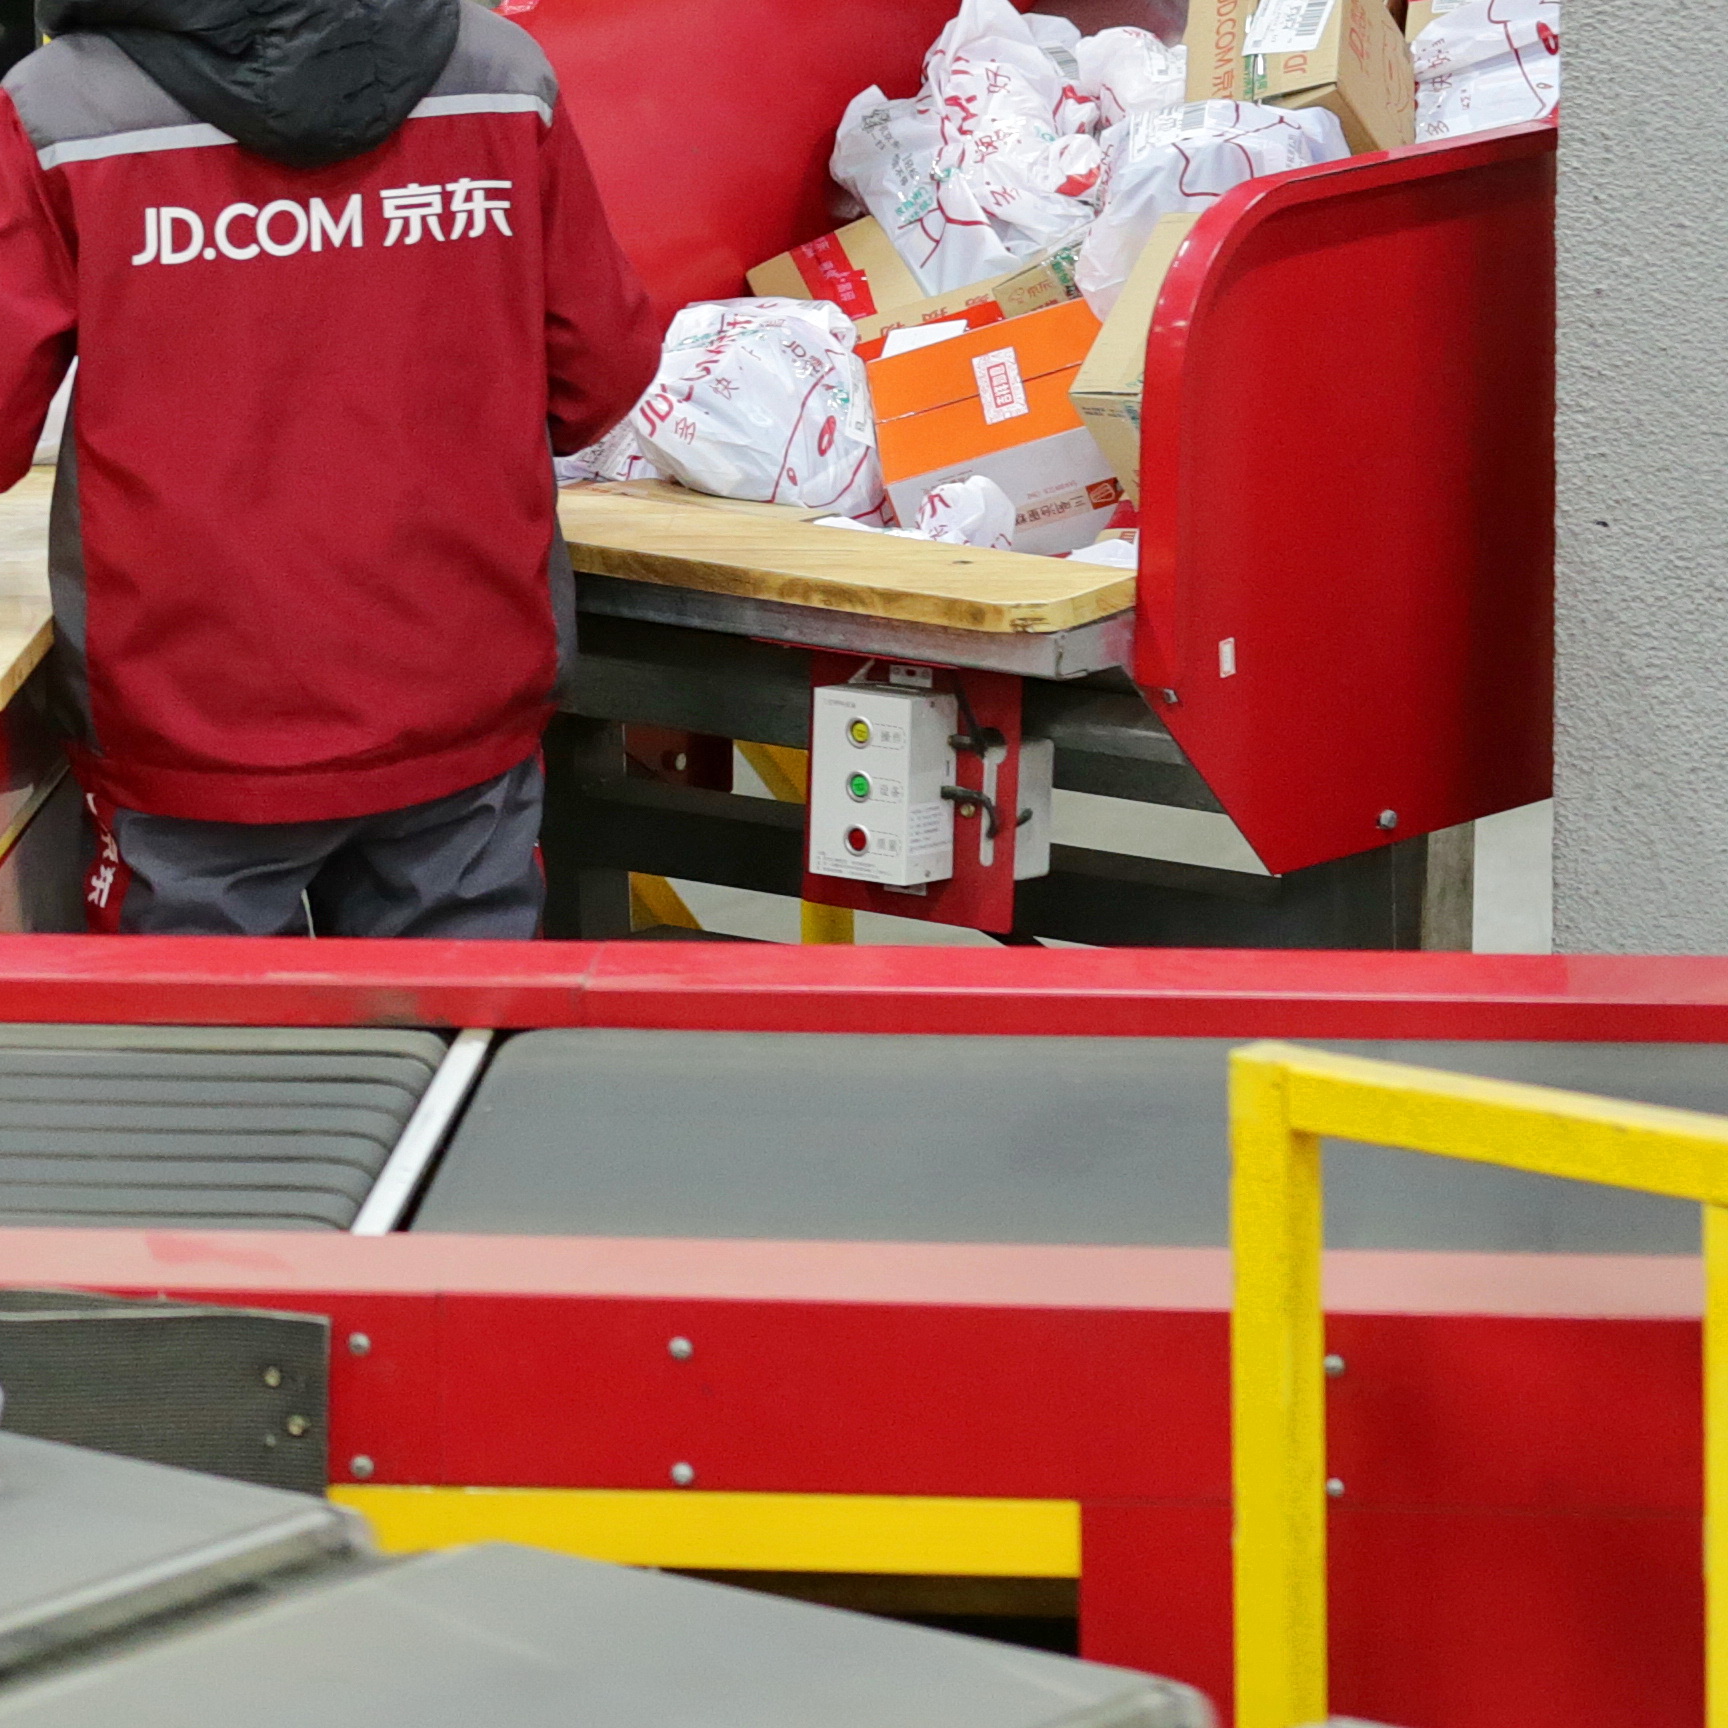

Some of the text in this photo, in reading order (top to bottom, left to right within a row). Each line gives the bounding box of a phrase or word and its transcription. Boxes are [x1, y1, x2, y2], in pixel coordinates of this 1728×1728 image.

[1211, 69, 1234, 99] 京
[131, 177, 513, 266] JD.COM 京东
